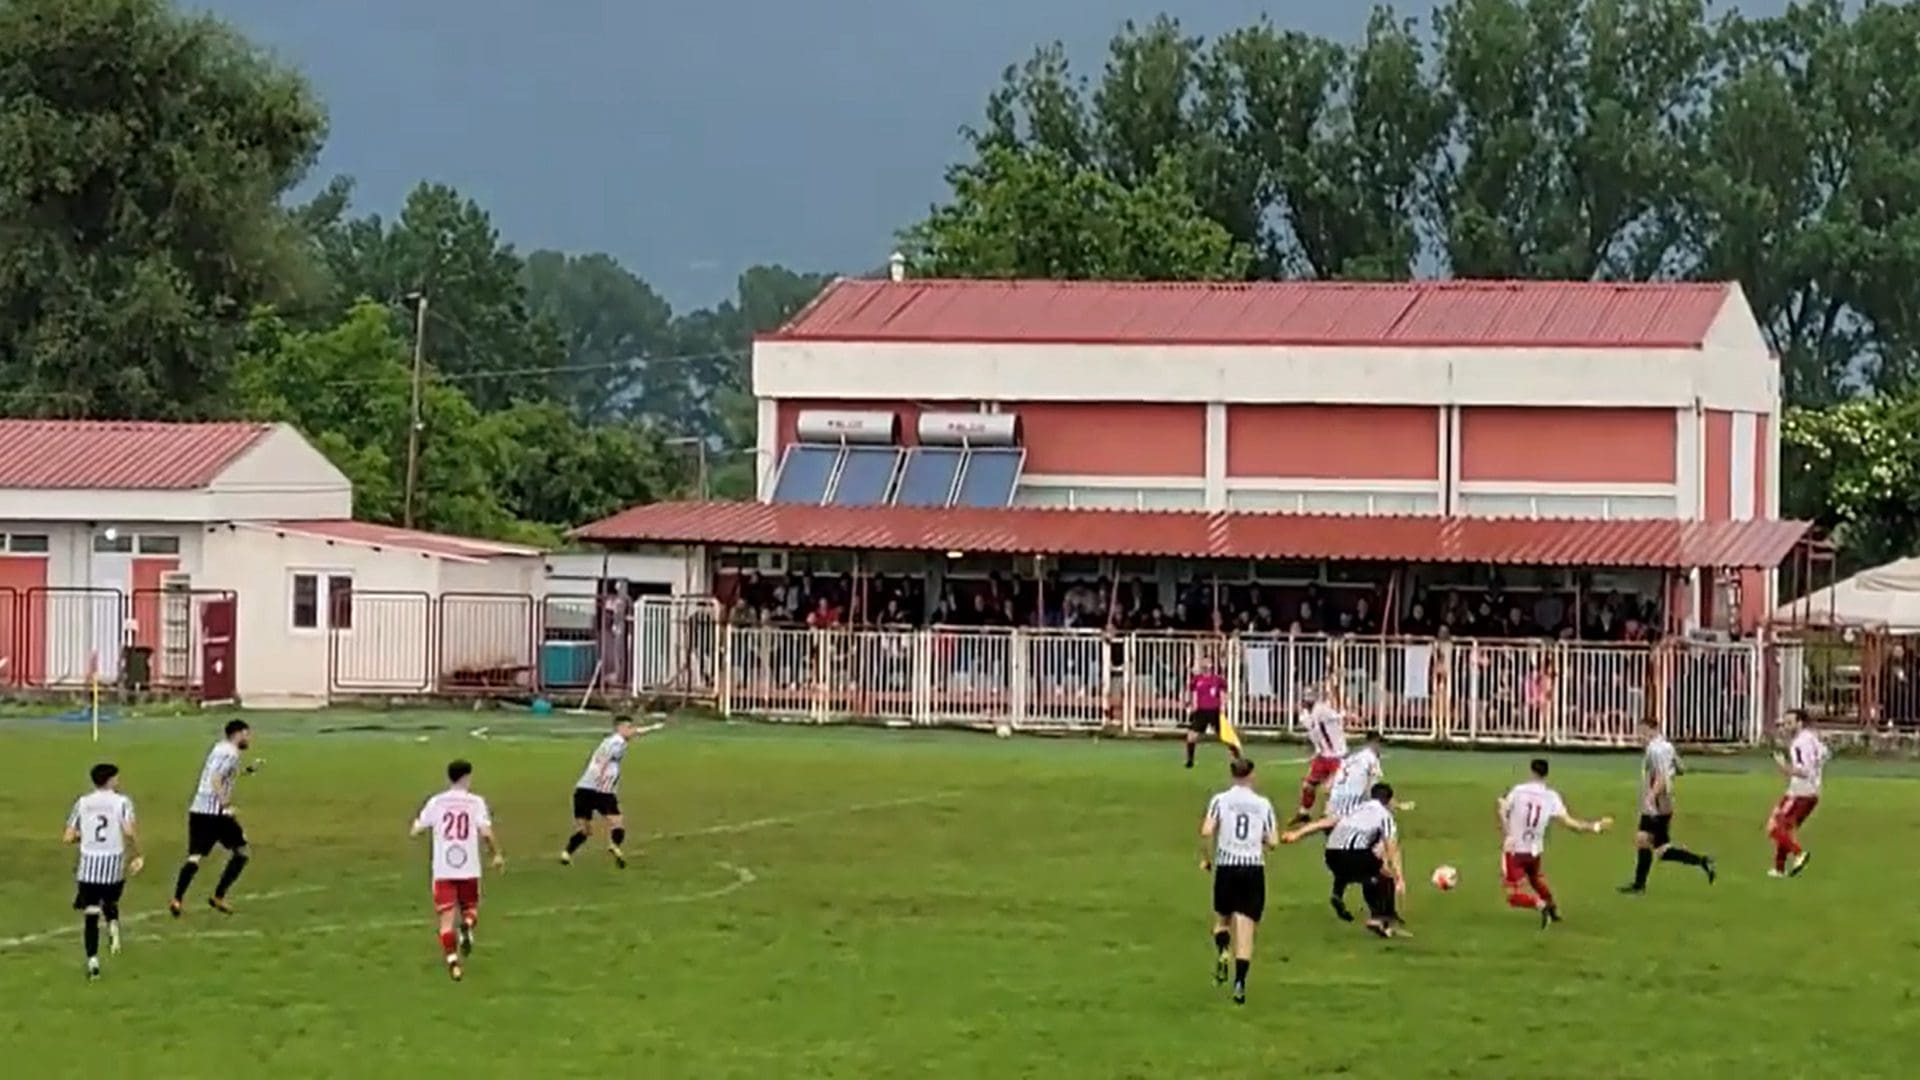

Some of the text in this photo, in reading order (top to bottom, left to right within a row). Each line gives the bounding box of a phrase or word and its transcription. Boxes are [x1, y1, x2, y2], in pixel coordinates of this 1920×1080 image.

[95, 815, 108, 842] 2
[443, 811, 469, 841] 20
[1236, 813, 1249, 840] 8
[1527, 802, 1541, 828] 11
